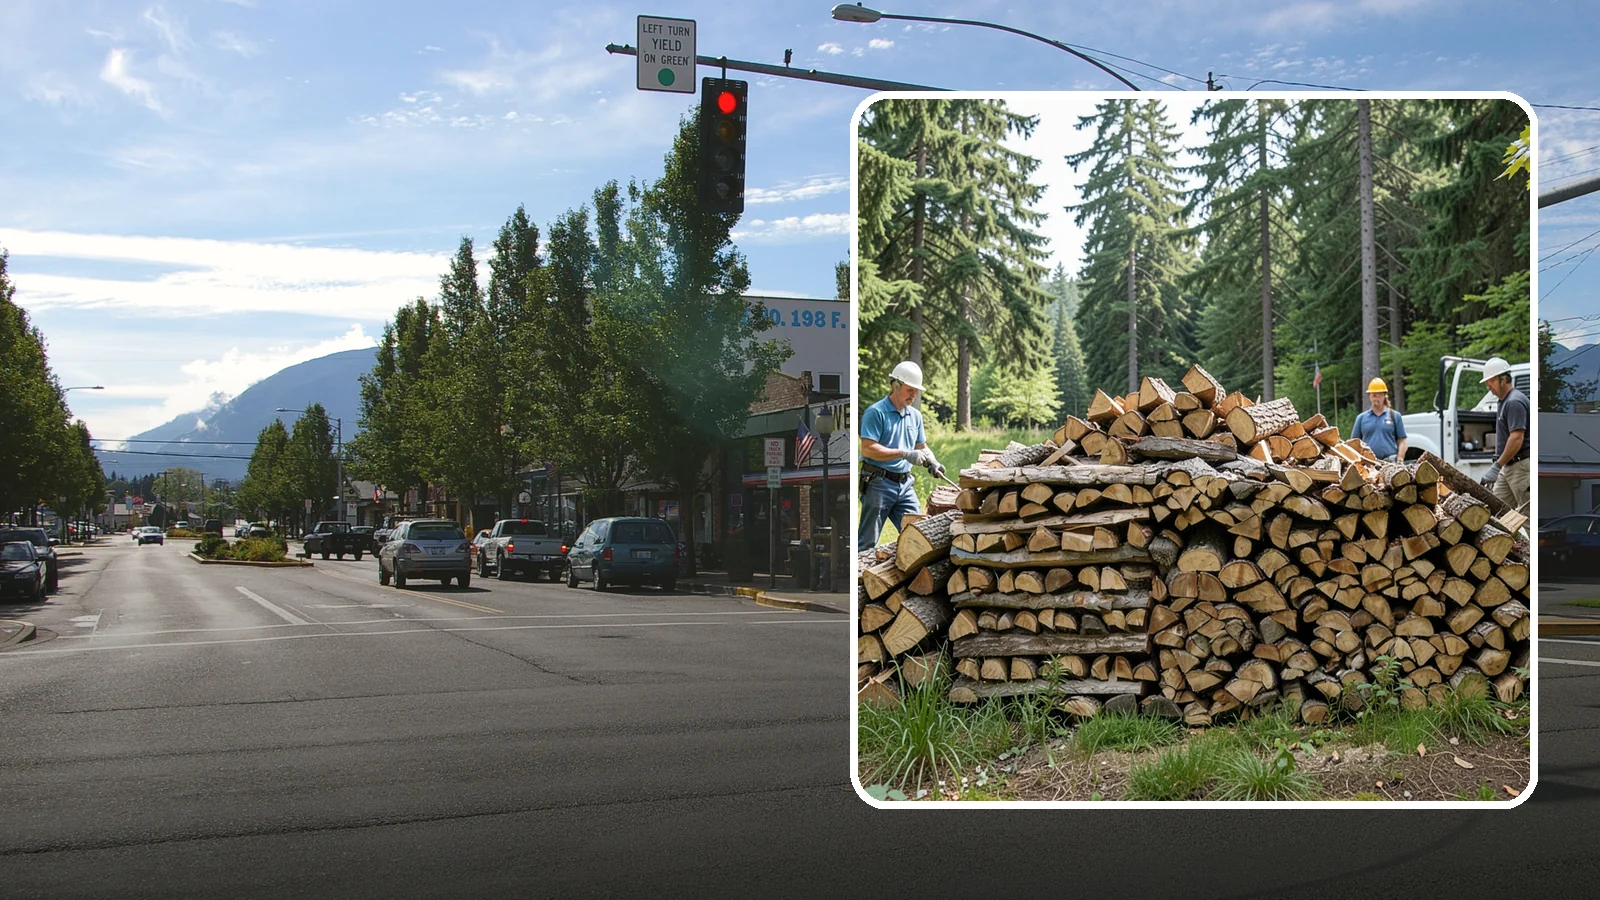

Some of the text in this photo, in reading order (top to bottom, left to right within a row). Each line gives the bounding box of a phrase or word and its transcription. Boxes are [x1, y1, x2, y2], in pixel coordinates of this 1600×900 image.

[643, 24, 690, 37] LEFT TURN
[652, 38, 682, 52] YIELD
[644, 53, 689, 66] ON GREEN
[791, 309, 826, 328] 198
[831, 311, 847, 329] F.
